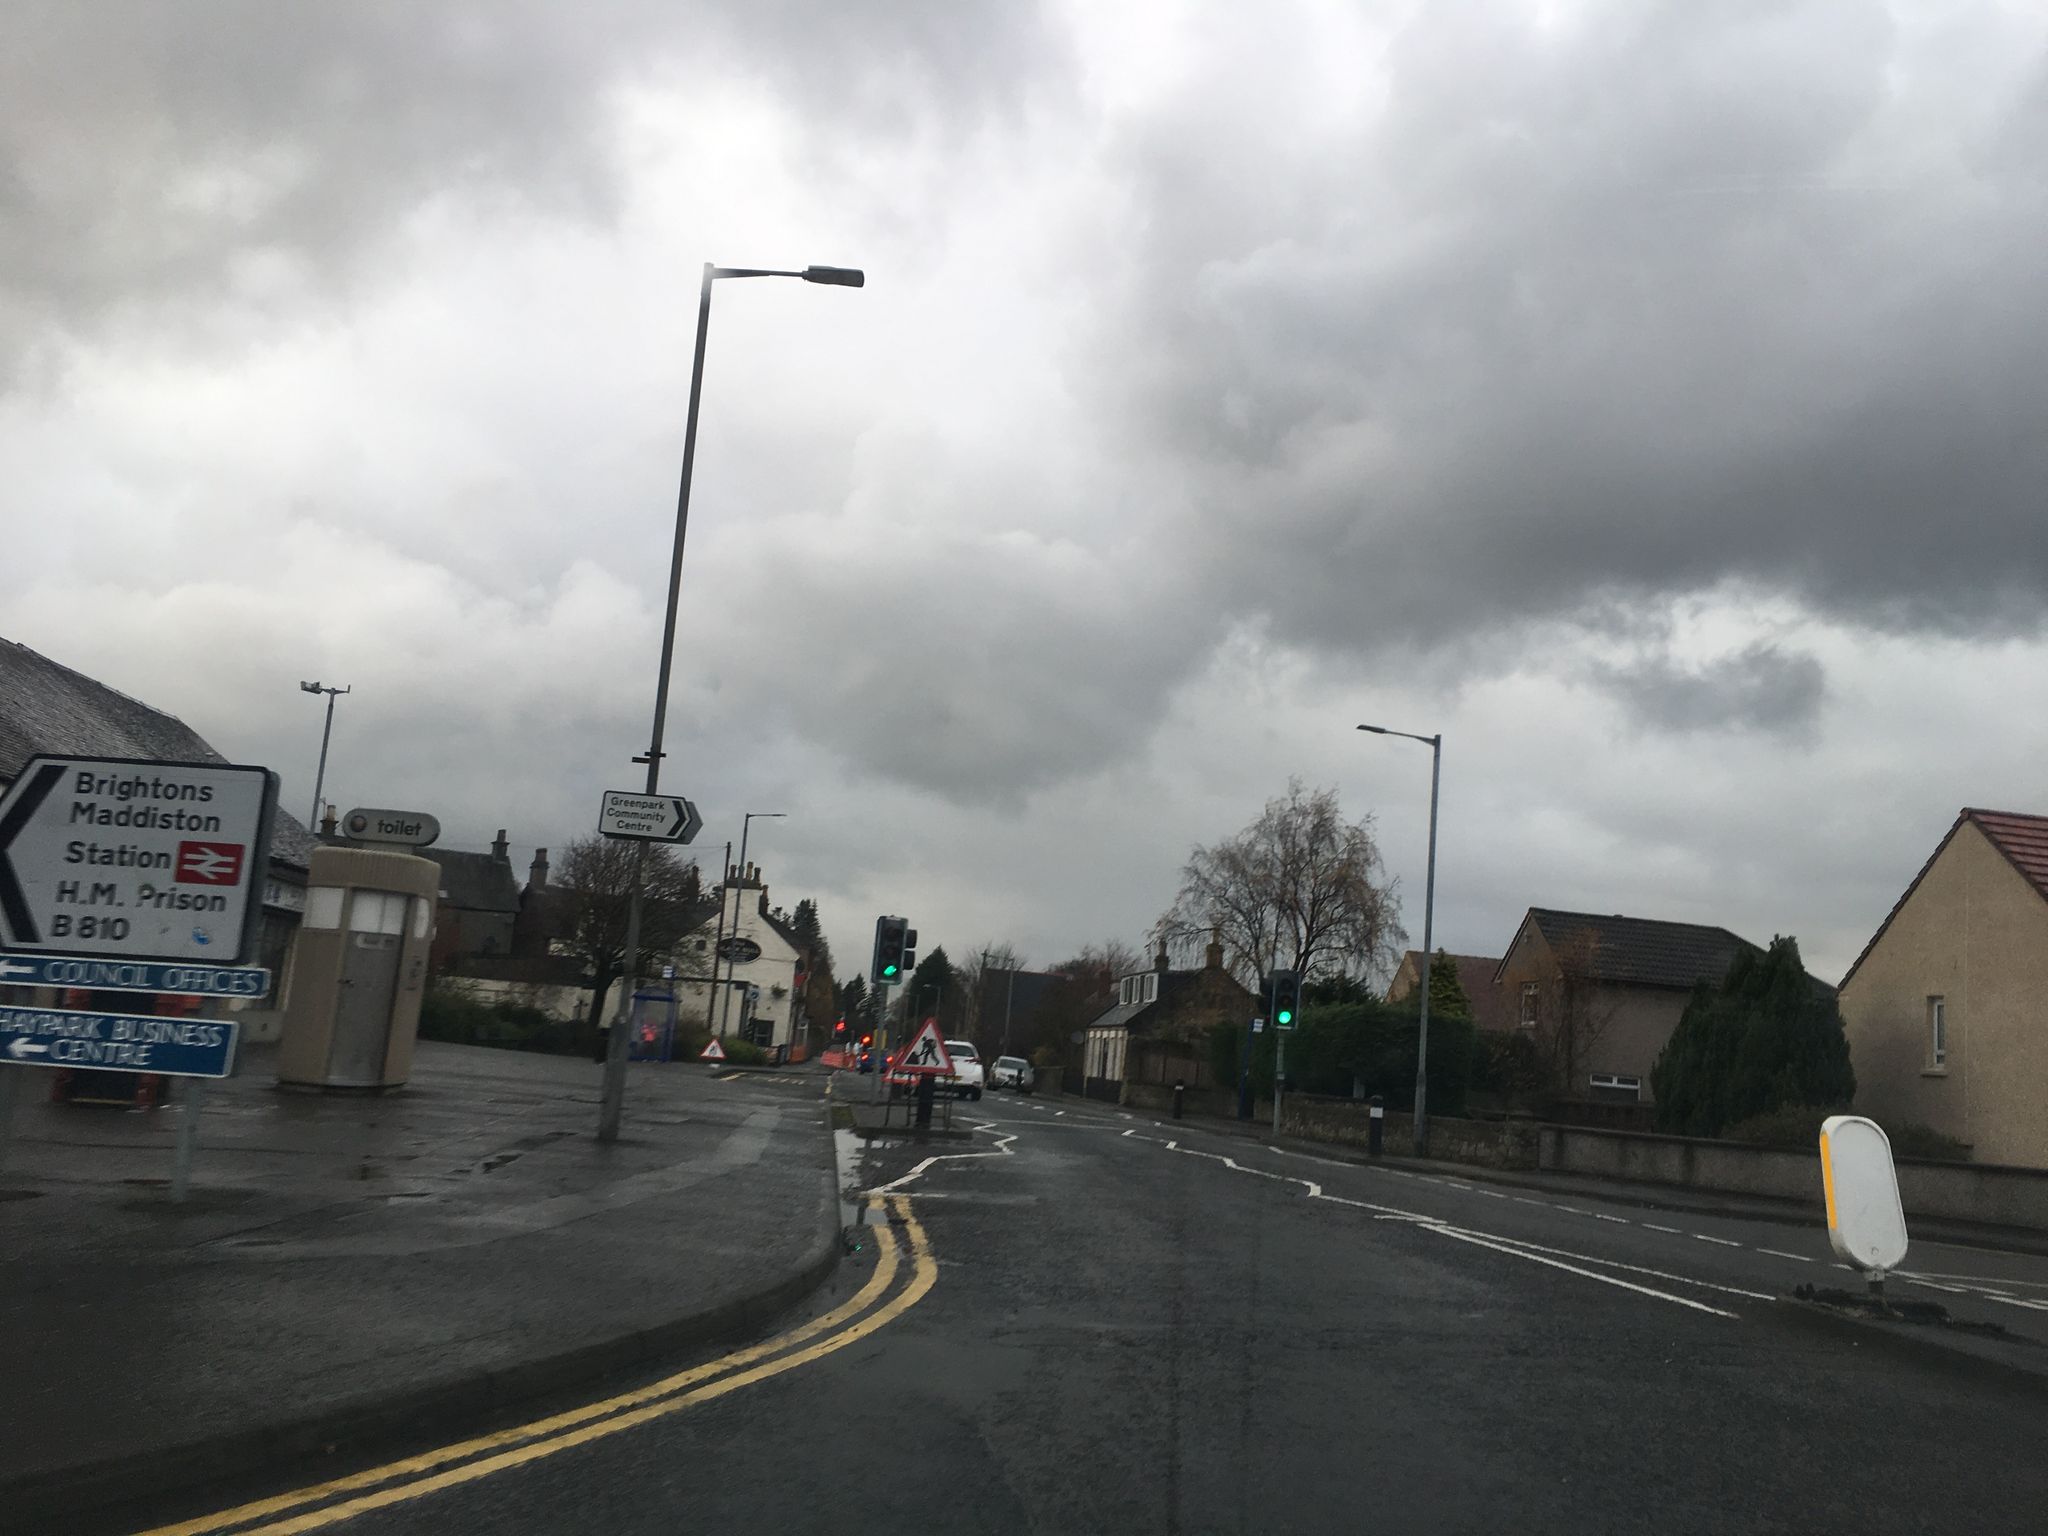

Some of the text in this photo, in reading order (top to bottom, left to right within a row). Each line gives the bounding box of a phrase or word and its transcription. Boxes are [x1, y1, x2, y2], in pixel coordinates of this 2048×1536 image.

[76, 771, 214, 802] Brightons
[70, 801, 221, 832] Maddiston
[606, 807, 666, 824] Community
[611, 796, 665, 810] Greenpark
[377, 819, 422, 836] toilet
[616, 819, 653, 832] Centre
[65, 840, 171, 869] Station
[56, 880, 226, 912] H.M. Prison
[51, 914, 130, 941] B810
[43, 961, 259, 993] COUNCIL OFFICES
[111, 1019, 223, 1047] BUSINESS
[50, 1038, 152, 1066] CENTRE
